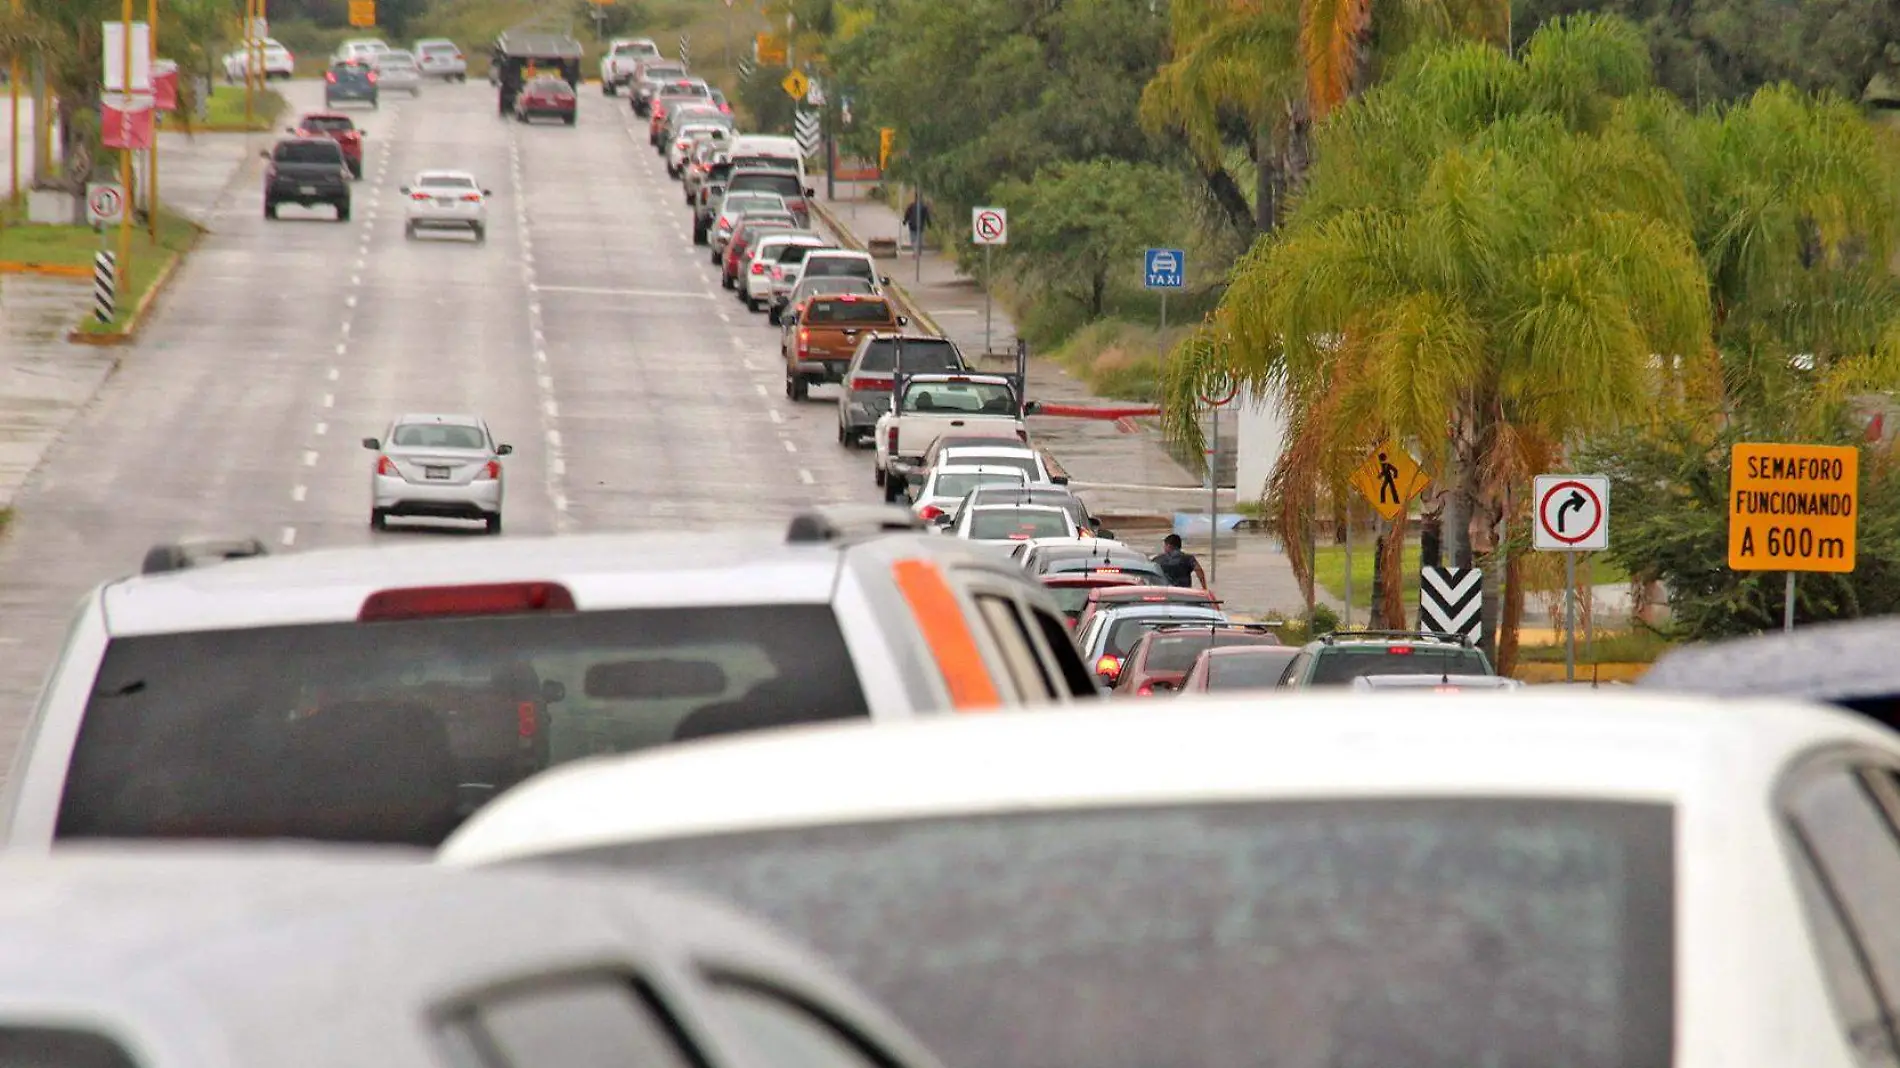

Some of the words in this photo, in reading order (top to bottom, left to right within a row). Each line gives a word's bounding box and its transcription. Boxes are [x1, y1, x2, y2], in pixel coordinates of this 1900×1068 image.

[1148, 275, 1180, 285] TAXI
[1748, 456, 1843, 480] SEMAFORO
[1736, 490, 1852, 517] FUNCIONANDO
[1741, 526, 1755, 557] A
